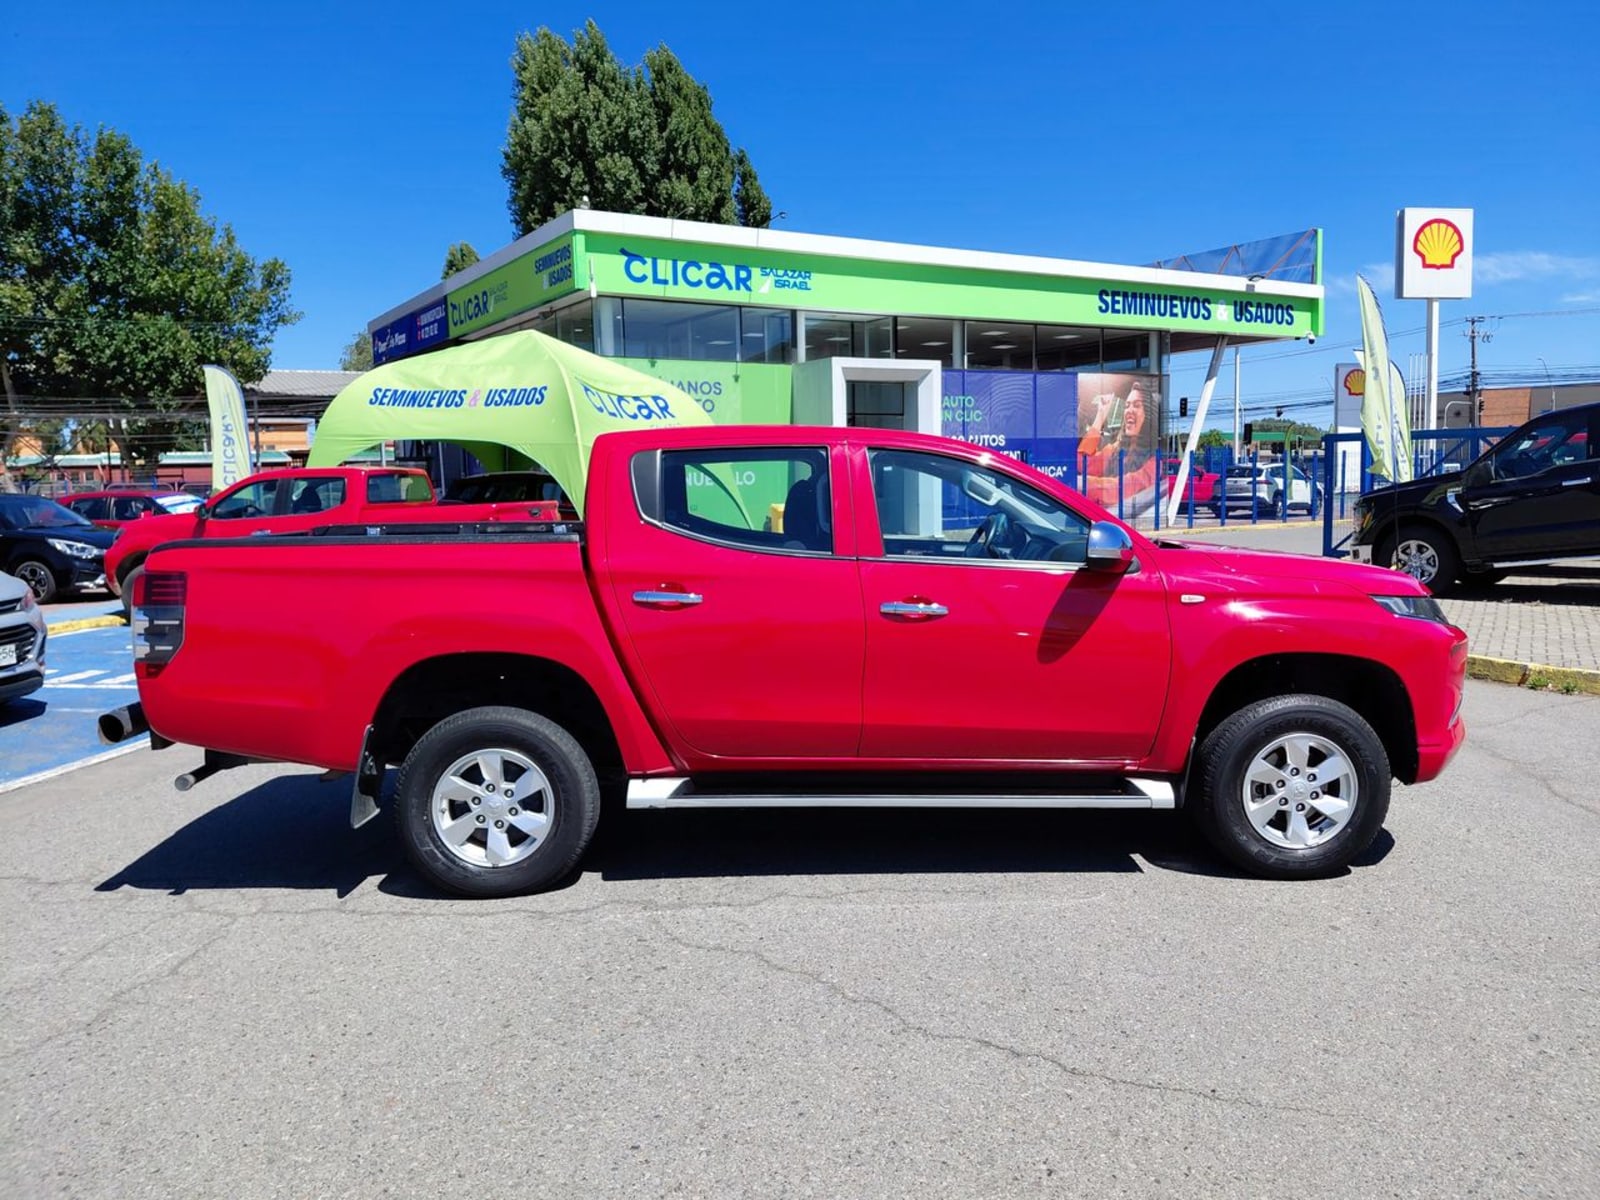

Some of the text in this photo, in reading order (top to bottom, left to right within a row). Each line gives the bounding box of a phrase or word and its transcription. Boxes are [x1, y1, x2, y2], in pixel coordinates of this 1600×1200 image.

[760, 267, 812, 281] SALAZAR
[774, 279, 812, 291] ISRAEL
[1098, 289, 1295, 326] SEMINUEVOS & USADOS
[368, 387, 467, 408] SEMINUEVOS
[484, 386, 548, 407] USADOS
[942, 395, 975, 408] AUTO
[954, 409, 983, 422] CLIC
